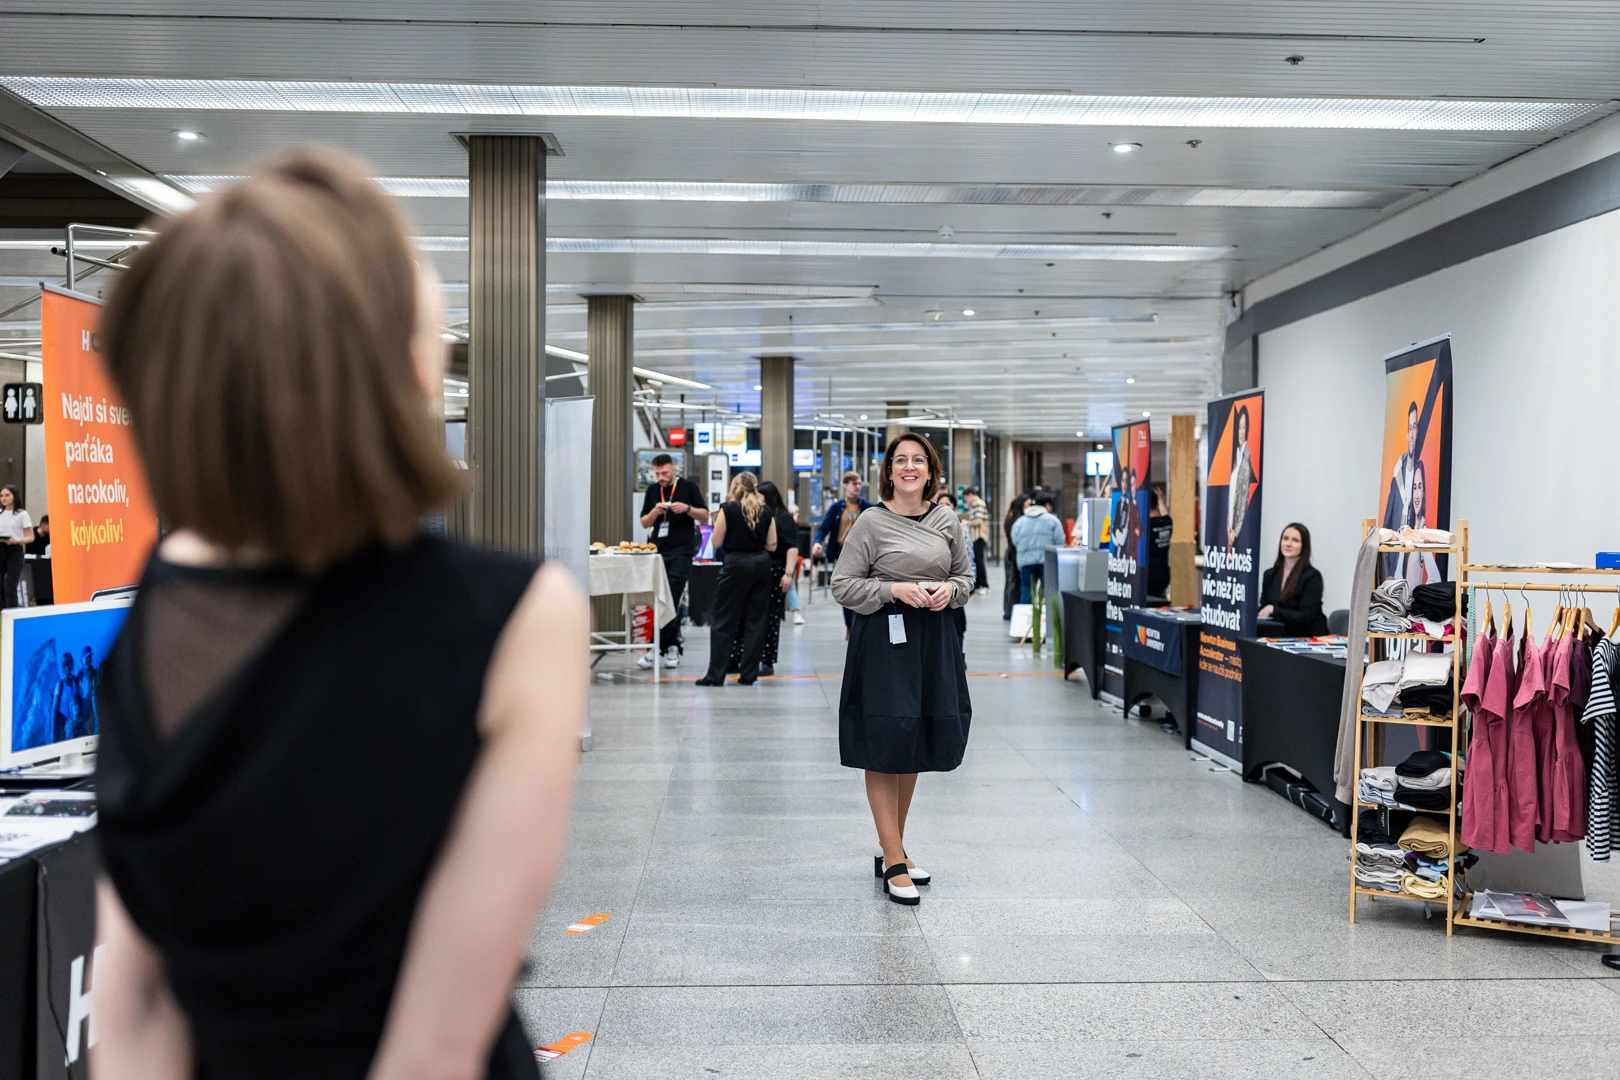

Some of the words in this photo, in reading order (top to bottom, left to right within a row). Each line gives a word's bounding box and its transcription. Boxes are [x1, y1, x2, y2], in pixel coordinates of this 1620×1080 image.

[61, 392, 93, 427] Najdi
[96, 398, 107, 424] si
[65, 432, 114, 468] parťáka
[68, 483, 84, 504] na
[85, 478, 129, 508] cokoliv,
[70, 518, 124, 551] kdykoliv!
[1108, 552, 1129, 578] Ready
[1129, 556, 1137, 575] to
[1203, 545, 1226, 573] Když
[1226, 546, 1252, 573] chceš
[1107, 577, 1122, 597] take
[1122, 583, 1132, 599] on
[1202, 573, 1216, 597] víc
[1216, 576, 1231, 600] než
[1231, 577, 1245, 605] jen
[1201, 603, 1240, 631] studovat
